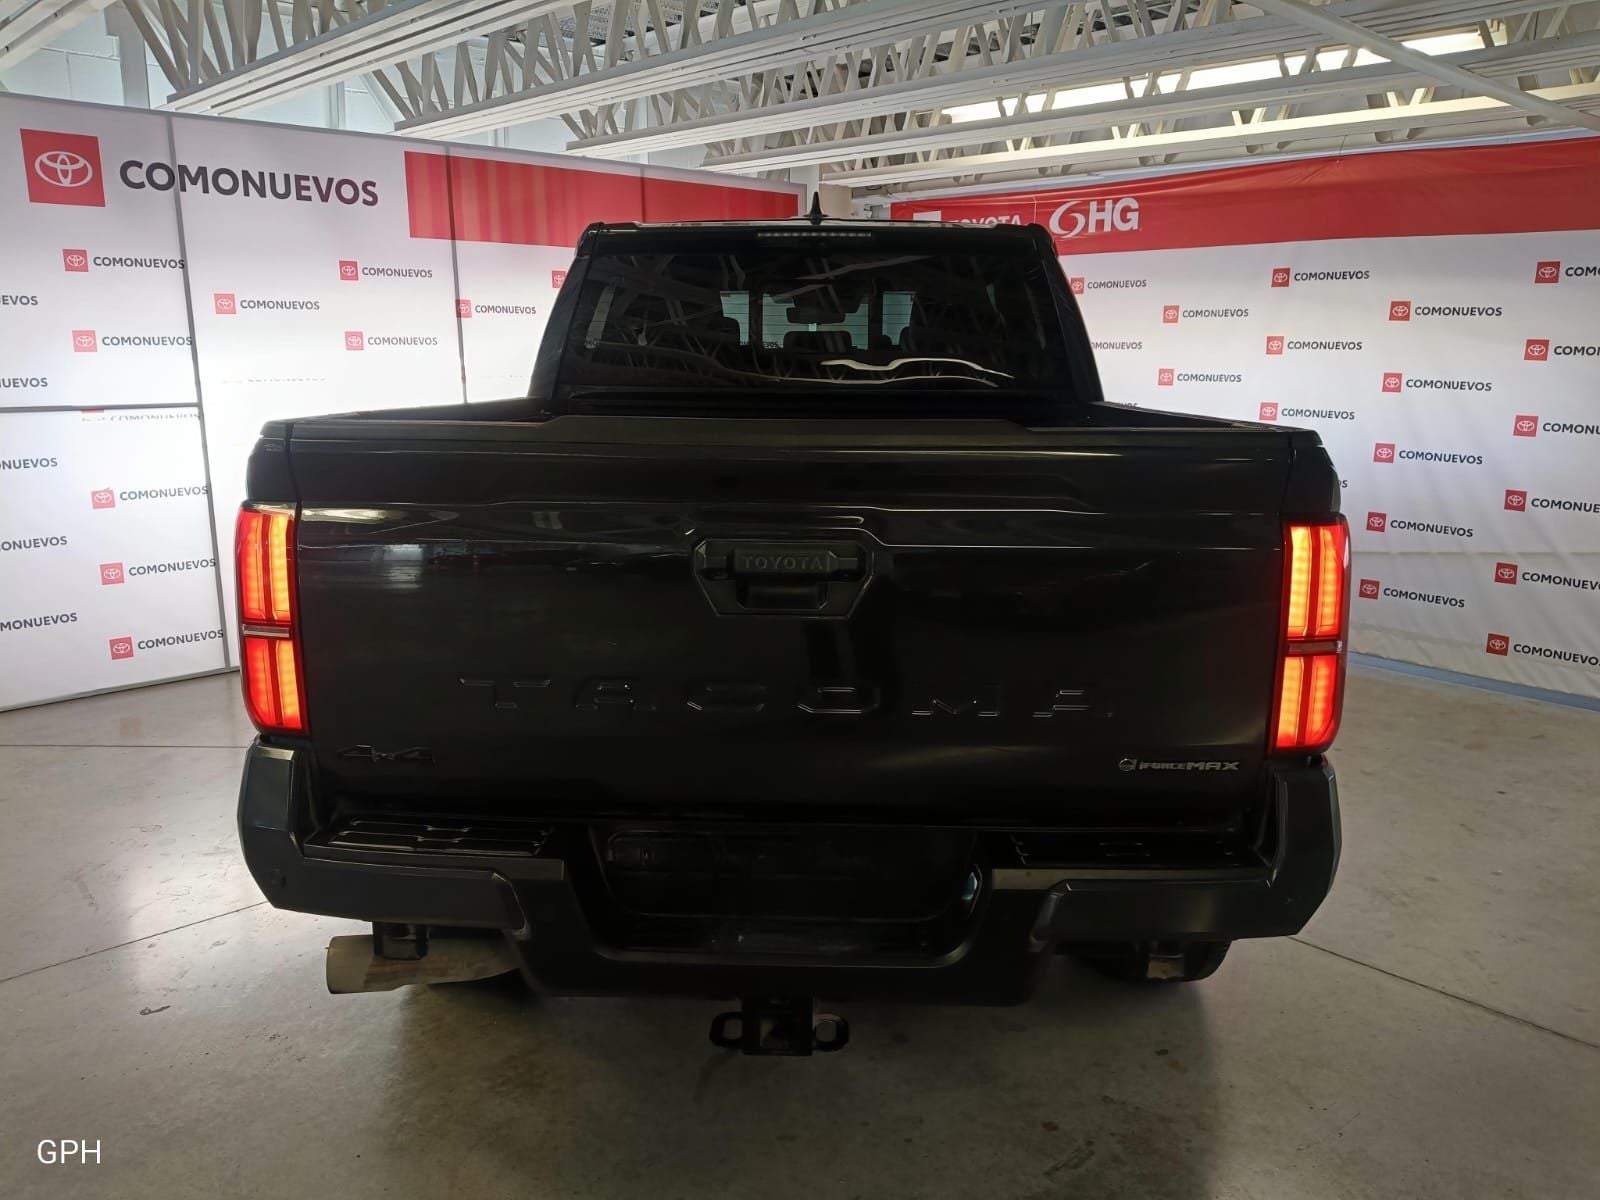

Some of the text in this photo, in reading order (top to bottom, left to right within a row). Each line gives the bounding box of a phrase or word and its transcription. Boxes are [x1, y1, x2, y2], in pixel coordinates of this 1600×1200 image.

[119, 160, 379, 206] COMONUEVOS
[93, 256, 185, 270] COMONUEVOS
[362, 266, 433, 278] COMONUEVOS
[1294, 270, 1370, 282] COMONUEVOS
[1565, 266, 1600, 277] COM
[1087, 279, 1147, 290] COMONUEVOS
[0, 295, 39, 306] EVOS
[240, 299, 320, 311] COMONUEVOS
[474, 304, 537, 315] COMONUEVOS
[1182, 308, 1249, 318] COMONUEVOS
[1414, 306, 1502, 317] COMONUEVOS
[102, 336, 193, 347] COMONUEVOS
[367, 336, 438, 346] COMONUEVOS
[1287, 341, 1363, 351] COMONUEVOS
[1177, 373, 1242, 383] COMONUEVOS
[1406, 378, 1493, 392] COMONUEVOS
[1281, 408, 1355, 420] COMONUEVOS
[0, 457, 58, 470] NUEVOS
[1399, 450, 1483, 465] COMONUEVOS
[120, 486, 209, 501] COMONUEVOS
[1390, 519, 1474, 538] COMONUEVOS
[129, 558, 217, 577] COMONUEVOS
[743, 556, 824, 570] TOYOTA
[1522, 571, 1600, 591] COMONUEV
[1383, 587, 1465, 608] COMONUEVOS
[137, 629, 224, 650] COMONUEVOS
[1513, 643, 1600, 667] COMONUEVO
